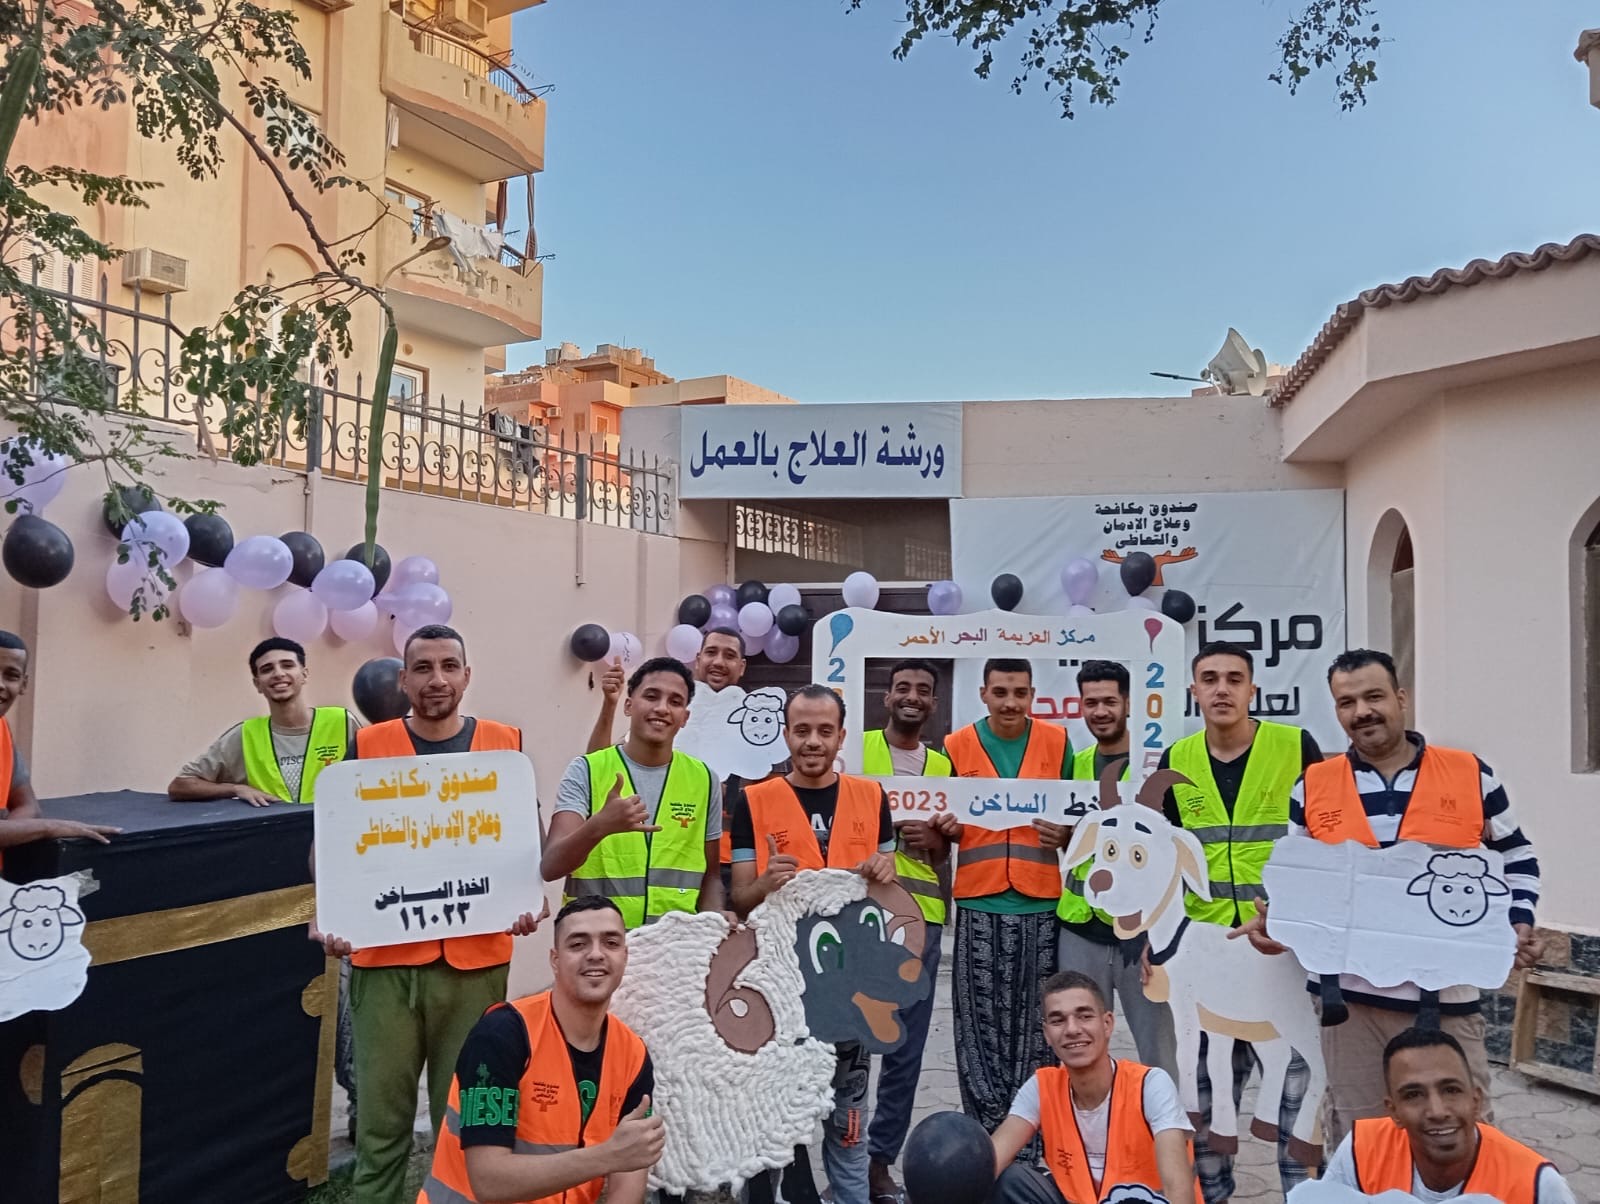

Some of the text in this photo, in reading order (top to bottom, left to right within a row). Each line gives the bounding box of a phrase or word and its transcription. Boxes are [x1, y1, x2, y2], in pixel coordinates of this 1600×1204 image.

[690, 422, 945, 485] ورشة العلاج بالعمل
[1095, 501, 1199, 517] صندوق مكافحة
[1103, 517, 1191, 535] وعلاج الإدمان
[899, 626, 1096, 647] مركز العزيمة البحر الأحمر
[1197, 601, 1323, 668] مركز
[355, 767, 498, 803] صندوق مكافحة
[887, 790, 948, 812] 6023
[968, 792, 1047, 817] الساخن
[374, 880, 453, 911] الساخن
